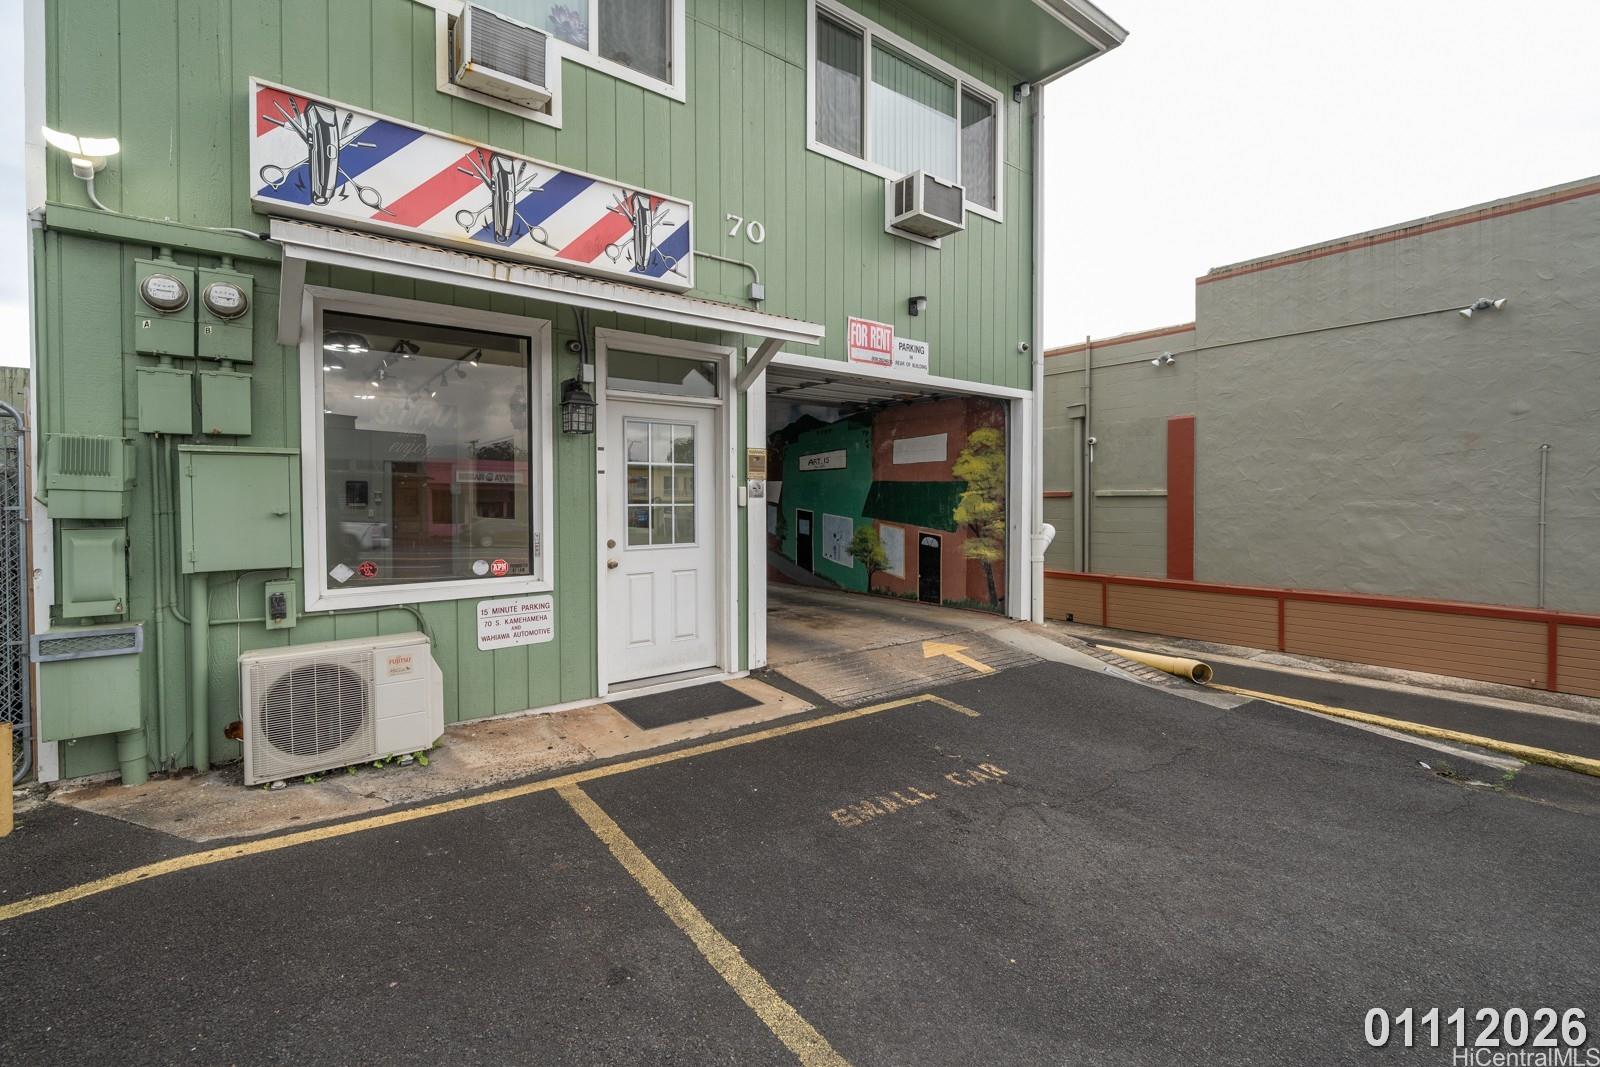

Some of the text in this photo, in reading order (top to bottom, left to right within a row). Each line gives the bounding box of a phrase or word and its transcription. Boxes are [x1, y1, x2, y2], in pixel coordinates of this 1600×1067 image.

[726, 212, 765, 243] 70
[851, 322, 891, 351] FOR RENT
[898, 342, 925, 354] PARKING
[481, 602, 551, 616] 15 MINUTE PARKING
[484, 620, 493, 628] 70
[504, 614, 548, 625] KAMEHAMEHA
[481, 627, 551, 642] WAHIAWA AUTOMOTIVE
